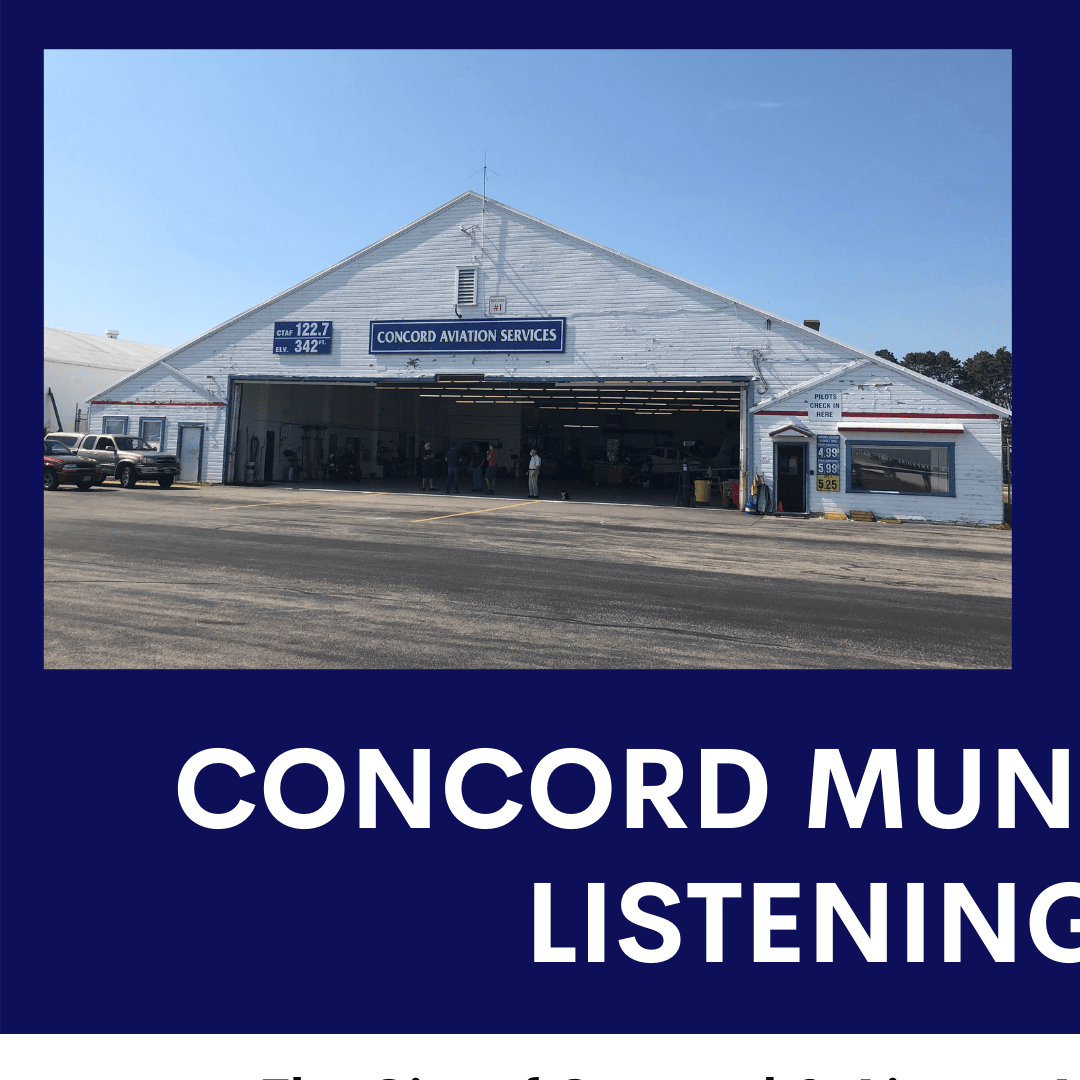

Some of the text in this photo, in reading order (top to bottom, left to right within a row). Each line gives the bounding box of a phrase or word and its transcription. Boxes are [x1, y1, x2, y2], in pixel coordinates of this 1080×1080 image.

[296, 322, 329, 336] 122.7
[377, 328, 557, 343] CONCORD AVIATION SERVICES
[294, 339, 319, 353] 342
[178, 748, 767, 829] CONCORD
